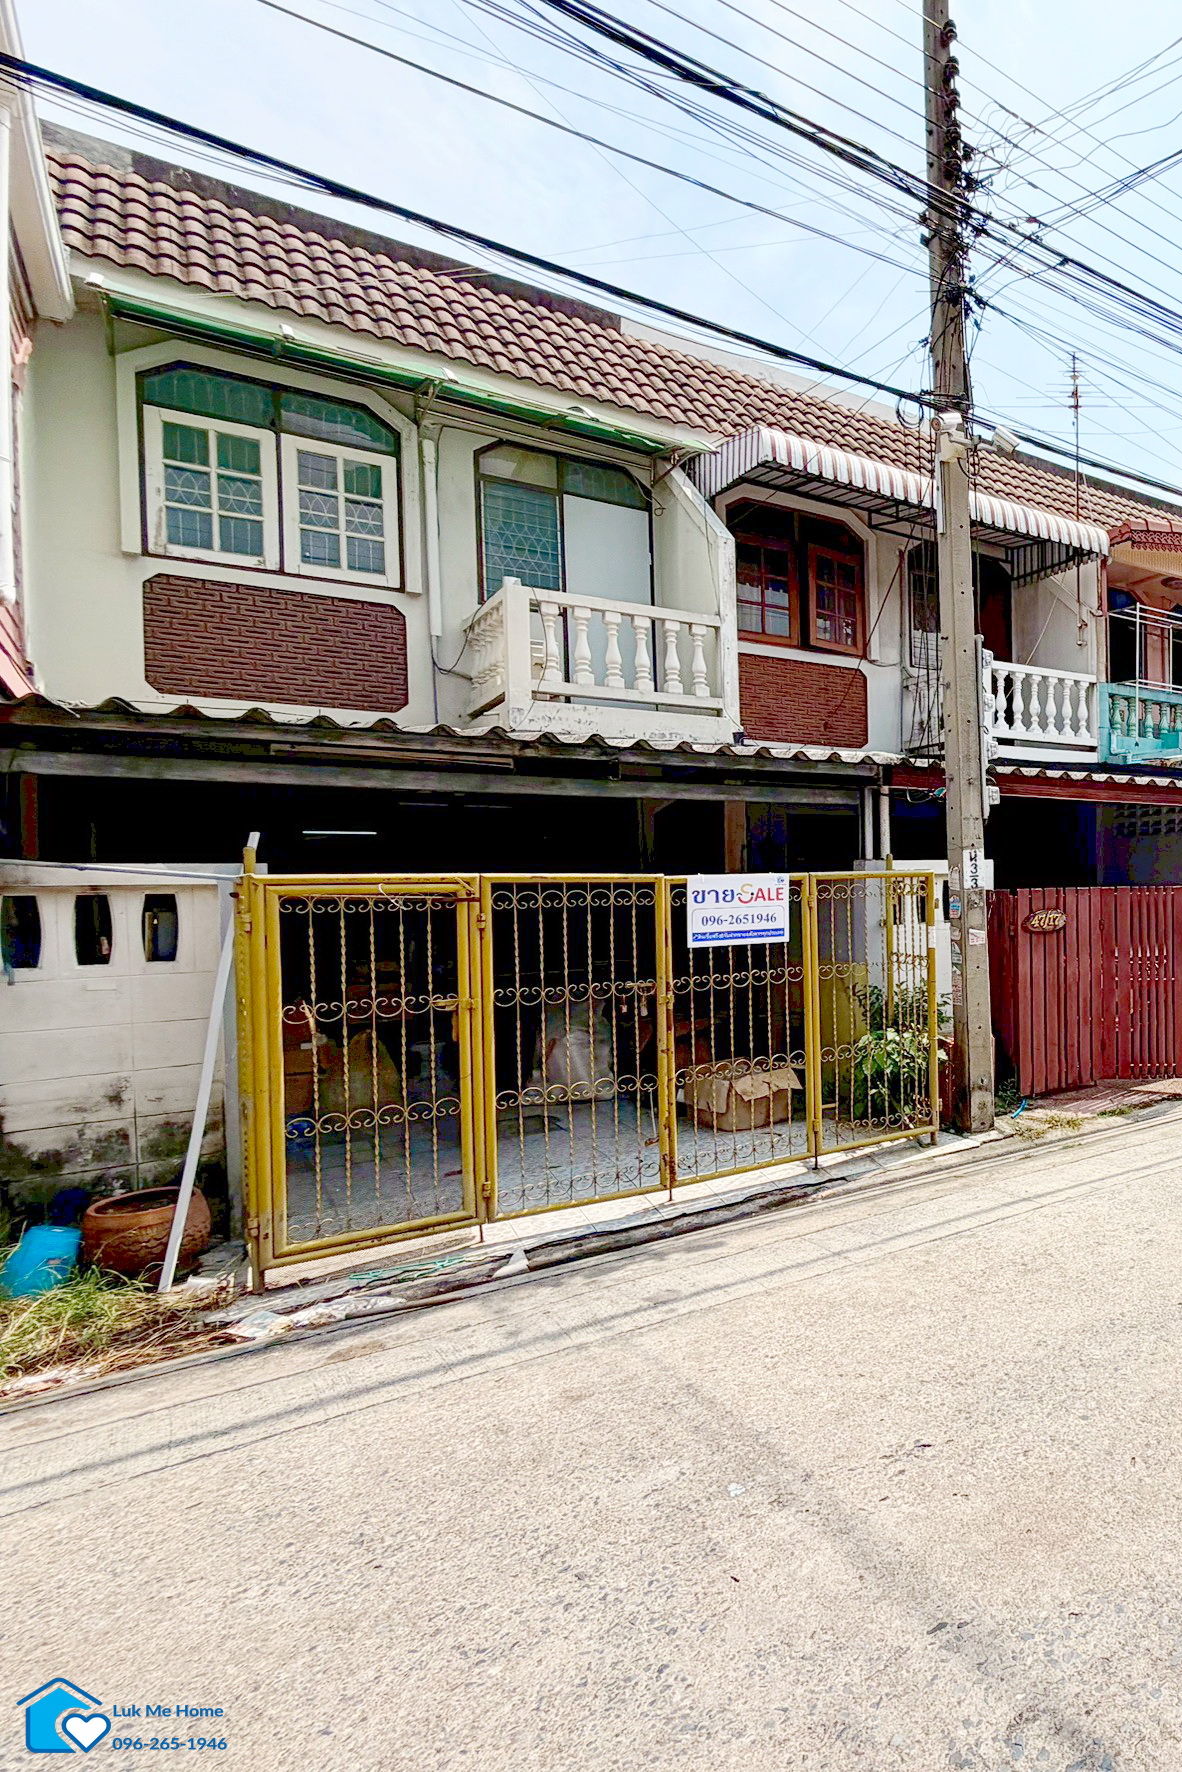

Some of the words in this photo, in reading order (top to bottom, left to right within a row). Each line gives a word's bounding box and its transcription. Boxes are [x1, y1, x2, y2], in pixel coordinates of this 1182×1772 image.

[691, 889, 735, 904] ขาย
[737, 883, 784, 904] SALE
[701, 912, 777, 927] 096-2651946
[1030, 909, 1062, 929] 47/17
